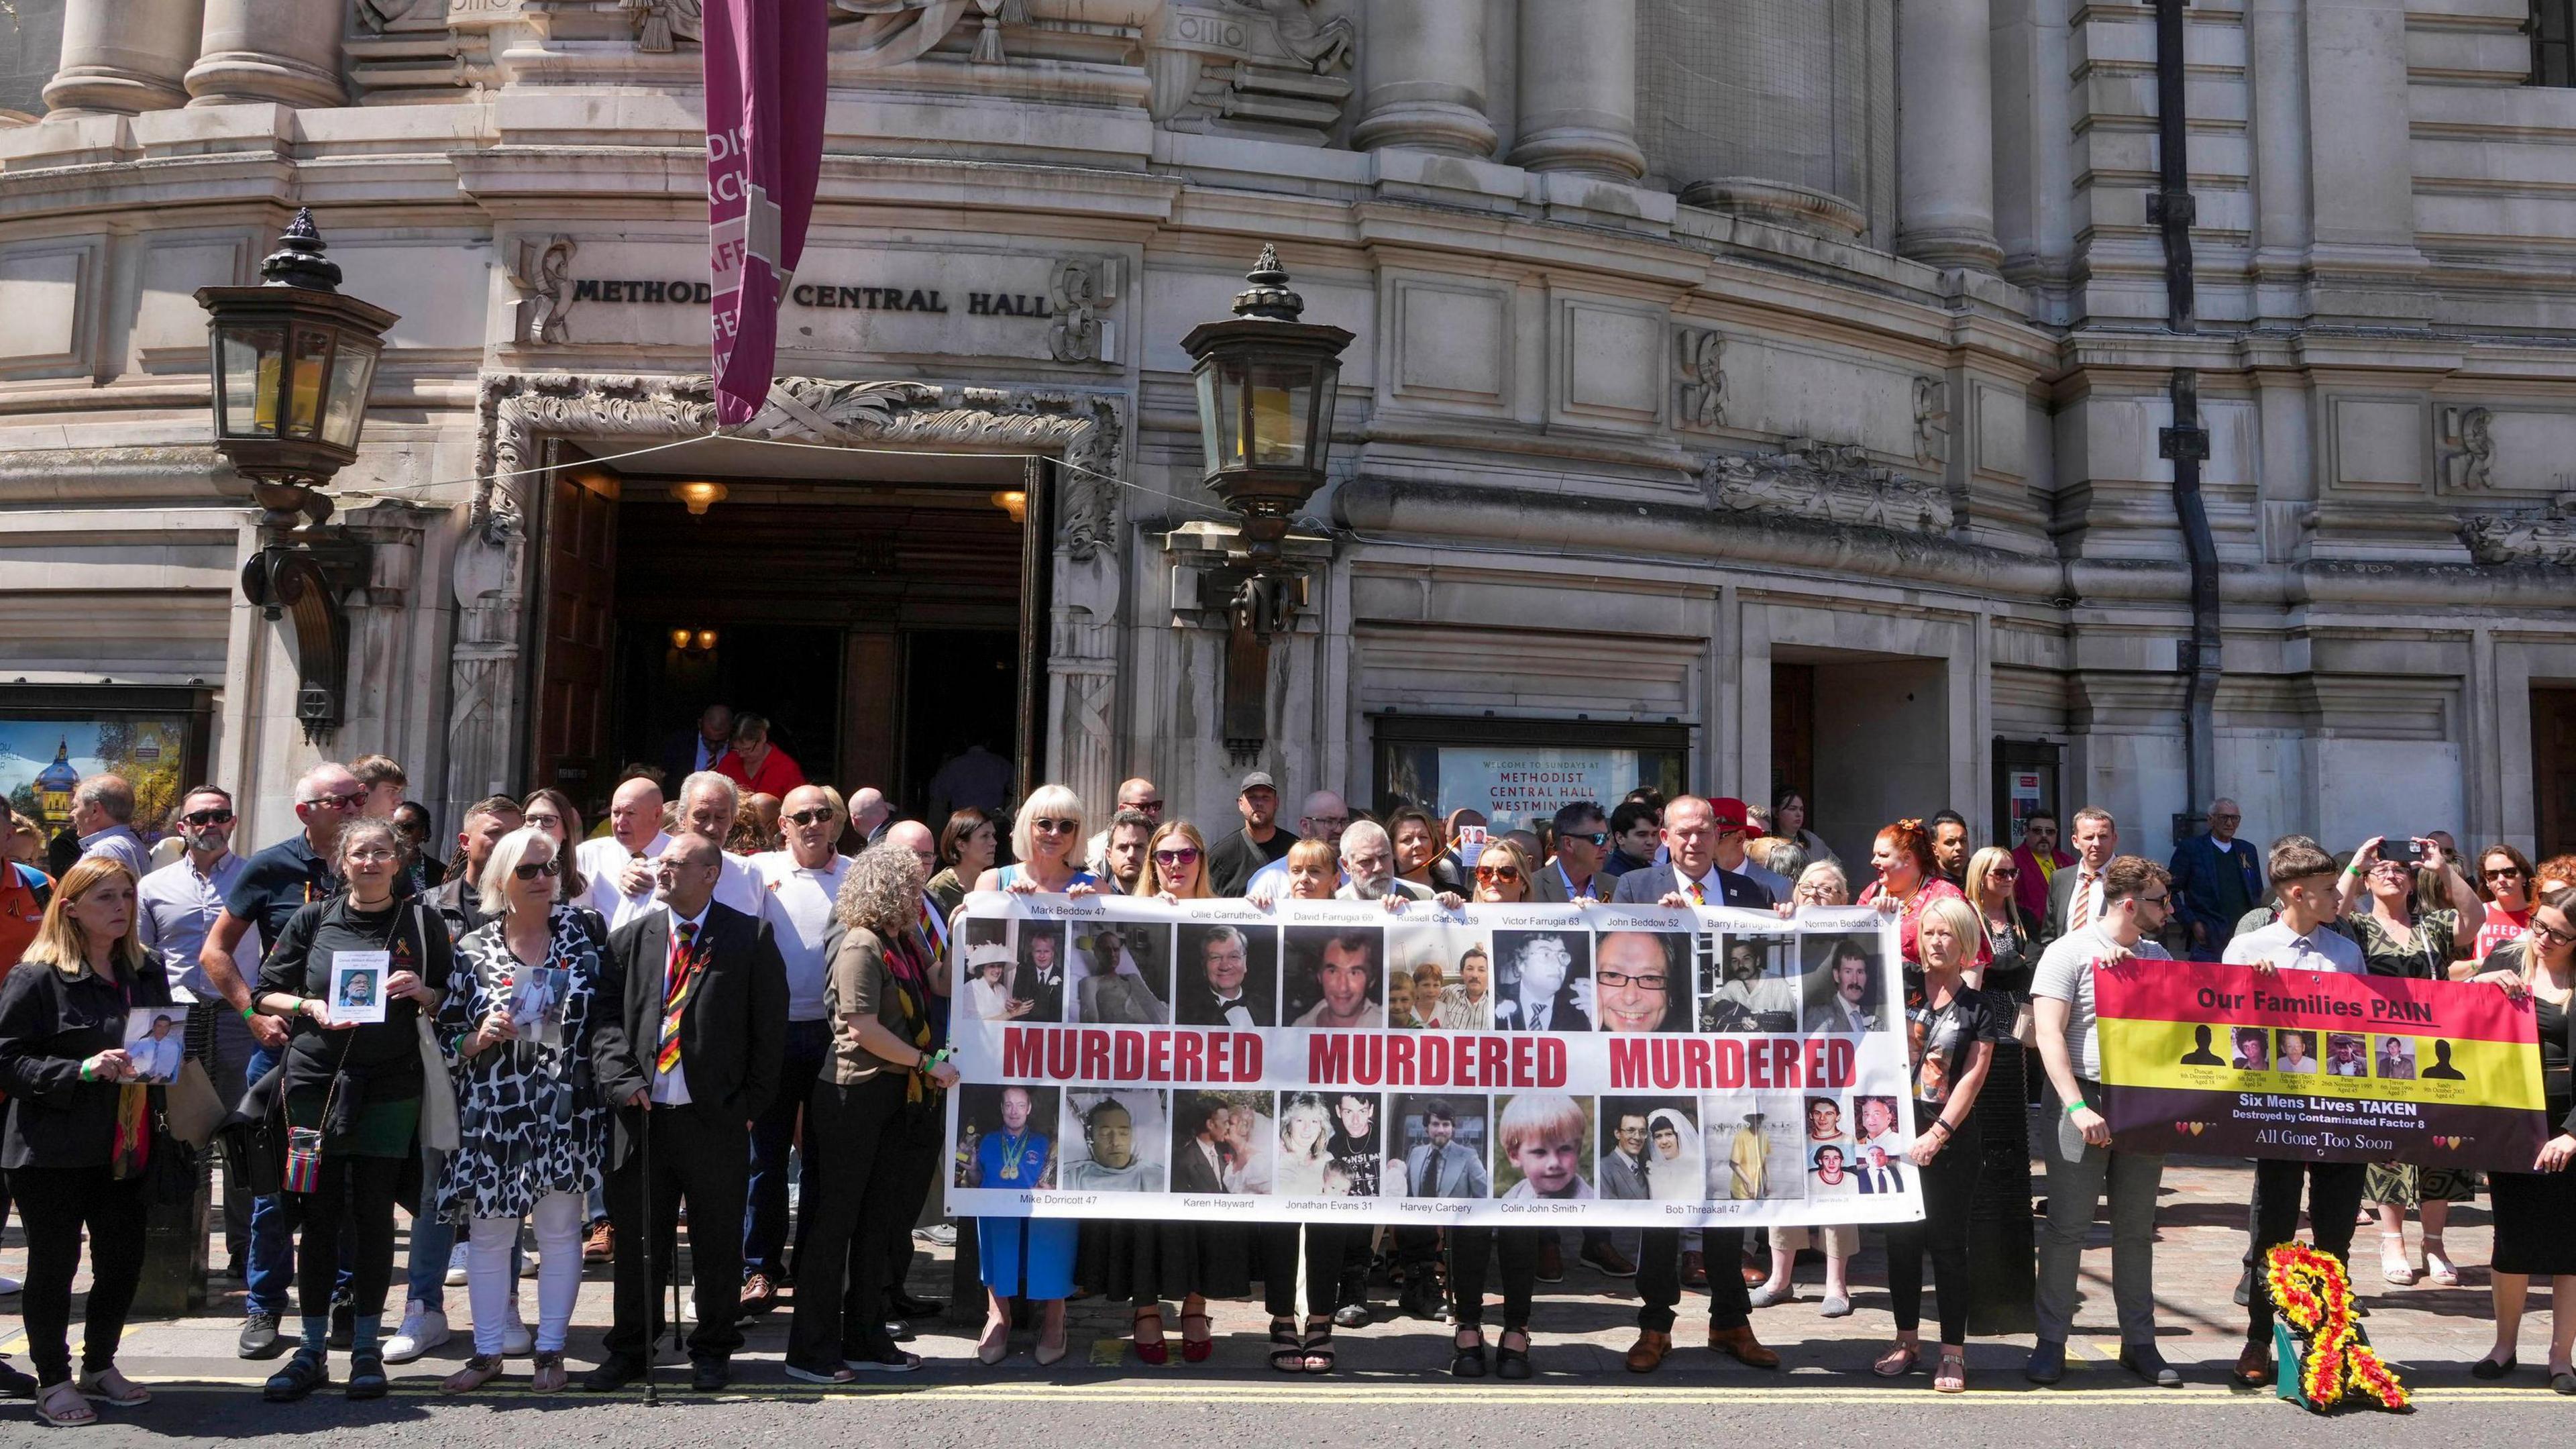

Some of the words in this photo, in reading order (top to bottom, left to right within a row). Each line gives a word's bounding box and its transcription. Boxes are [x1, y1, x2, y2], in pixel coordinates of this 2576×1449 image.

[793, 284, 947, 313] CENTRAL
[969, 293, 1053, 319] HALL
[1501, 773, 1583, 783] METHODIST
[1491, 787, 1553, 797] CENTRAL
[1560, 787, 1595, 797] HALL
[1031, 906, 1054, 916] Mark
[1057, 906, 1093, 916] Beddow
[1095, 908, 1106, 916] 47
[1191, 910, 1211, 919] Ollie
[1214, 910, 1261, 920] Carruthers
[1294, 912, 1320, 921] David
[1322, 913, 1360, 924] Farrugia
[1362, 914, 1374, 922] 69
[1397, 914, 1430, 922] Russell
[1432, 914, 1466, 926] Carbery
[1467, 916, 1479, 926] 39
[1502, 917, 1527, 926] Victor
[1530, 918, 1566, 928] Farrugia
[1568, 918, 1580, 926] 63
[1607, 918, 1629, 927] John
[1631, 918, 1665, 927] Beddow
[1668, 918, 1679, 927] 52
[1805, 919, 1838, 928] Norman
[1840, 919, 1871, 928] Beddow
[1873, 919, 1884, 928] 30
[1708, 919, 1731, 930] Barry
[1734, 920, 1770, 930] Farrugia
[2197, 988, 2245, 1009] Our
[2253, 990, 2363, 1017] Families
[2371, 999, 2432, 1022] PAIN
[1003, 1027, 1263, 1083] MURDERED
[1309, 1033, 1567, 1087] MURDERED
[1609, 1038, 1856, 1090] MURDERED
[2239, 1093, 2263, 1107] Six
[2267, 1095, 2305, 1109] Mens
[2310, 1097, 2355, 1113] Lives
[2359, 1100, 2417, 1116] TAKEN
[2233, 1110, 2282, 1122] Destroyed
[2284, 1112, 2296, 1123] by
[2298, 1114, 2377, 1126] Contaminated
[2379, 1118, 2415, 1128] Factor
[2418, 1120, 2425, 1129] 8
[2255, 1128, 2277, 1144] All
[2281, 1130, 2318, 1146] Gone
[2320, 1132, 2350, 1148] Too
[2355, 1134, 2394, 1150] Soon
[1020, 1195, 1042, 1204] Mike
[1044, 1195, 1084, 1205] Dorricott
[1086, 1196, 1097, 1205] 47
[1183, 1198, 1211, 1208] Karen
[1214, 1198, 1254, 1210] Hayward
[1285, 1201, 1328, 1210] Jonathan
[1331, 1201, 1359, 1210] Evans
[1361, 1201, 1373, 1211] 31
[1401, 1203, 1433, 1215] Harvey
[1436, 1203, 1472, 1215] Carbery
[1501, 1203, 1525, 1213] Colin
[1527, 1203, 1550, 1214] John
[1552, 1203, 1578, 1214] Smith
[1580, 1205, 1586, 1213] 7
[1666, 1205, 1684, 1214] Bob
[1687, 1205, 1726, 1215] Threakall
[1729, 1205, 1740, 1214] 47
